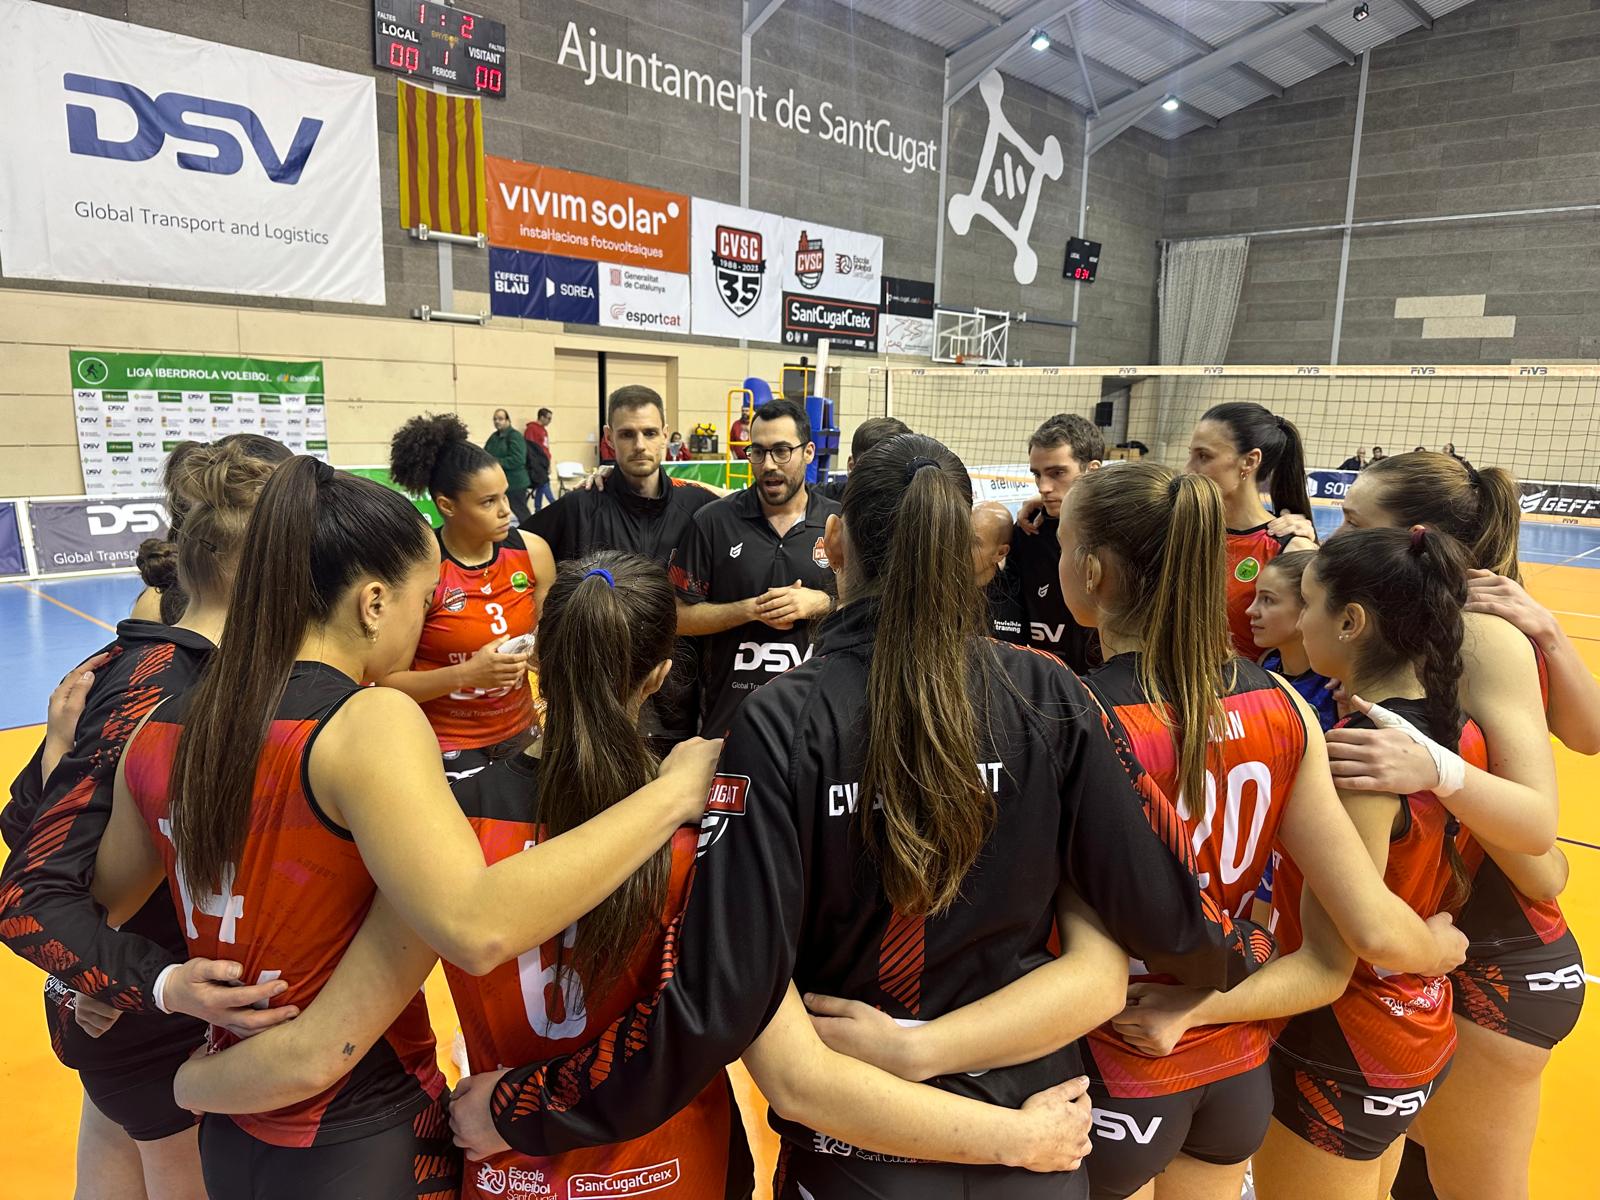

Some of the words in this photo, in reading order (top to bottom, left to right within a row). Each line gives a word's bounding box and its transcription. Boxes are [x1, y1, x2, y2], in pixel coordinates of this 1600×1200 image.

[377, 11, 396, 22] FALTES
[382, 22, 419, 43] LOCAL
[461, 15, 474, 39] 2
[468, 46, 501, 64] VISITANT
[488, 42, 505, 53] FALTES
[390, 42, 419, 71] 00
[444, 50, 449, 65] 1
[432, 66, 457, 79] PERIODE
[475, 65, 501, 92] 00
[557, 21, 767, 122] Ajuntament
[775, 88, 811, 134] de
[819, 102, 937, 174] SantCugat
[63, 72, 324, 185] DSV
[74, 200, 134, 223] Global
[139, 208, 225, 235] Transport
[230, 220, 260, 238] and
[264, 224, 329, 246] Logistics
[591, 235, 663, 259] fotovoltaiques
[720, 232, 758, 261] CVSC
[720, 259, 738, 270] 1988
[797, 253, 822, 271] CVSC
[624, 271, 659, 282] Generalitat
[494, 280, 530, 295] BLAU
[560, 283, 595, 299] SOREA
[624, 281, 632, 289] de
[634, 281, 666, 294] Catalunya
[719, 270, 760, 306] 35
[626, 311, 681, 327] esportcat
[126, 368, 152, 378] LIGA
[155, 368, 220, 381] IBERDROLA
[221, 370, 272, 383] VOLEIBOL
[53, 551, 94, 564] Global
[485, 602, 508, 635] 3
[995, 625, 1021, 634] training
[731, 681, 749, 690] Global
[517, 920, 587, 1040] 6
[508, 1166, 544, 1181] Escola
[575, 1168, 672, 1192] SantCugatCreix
[508, 1178, 551, 1193] Voleibol
